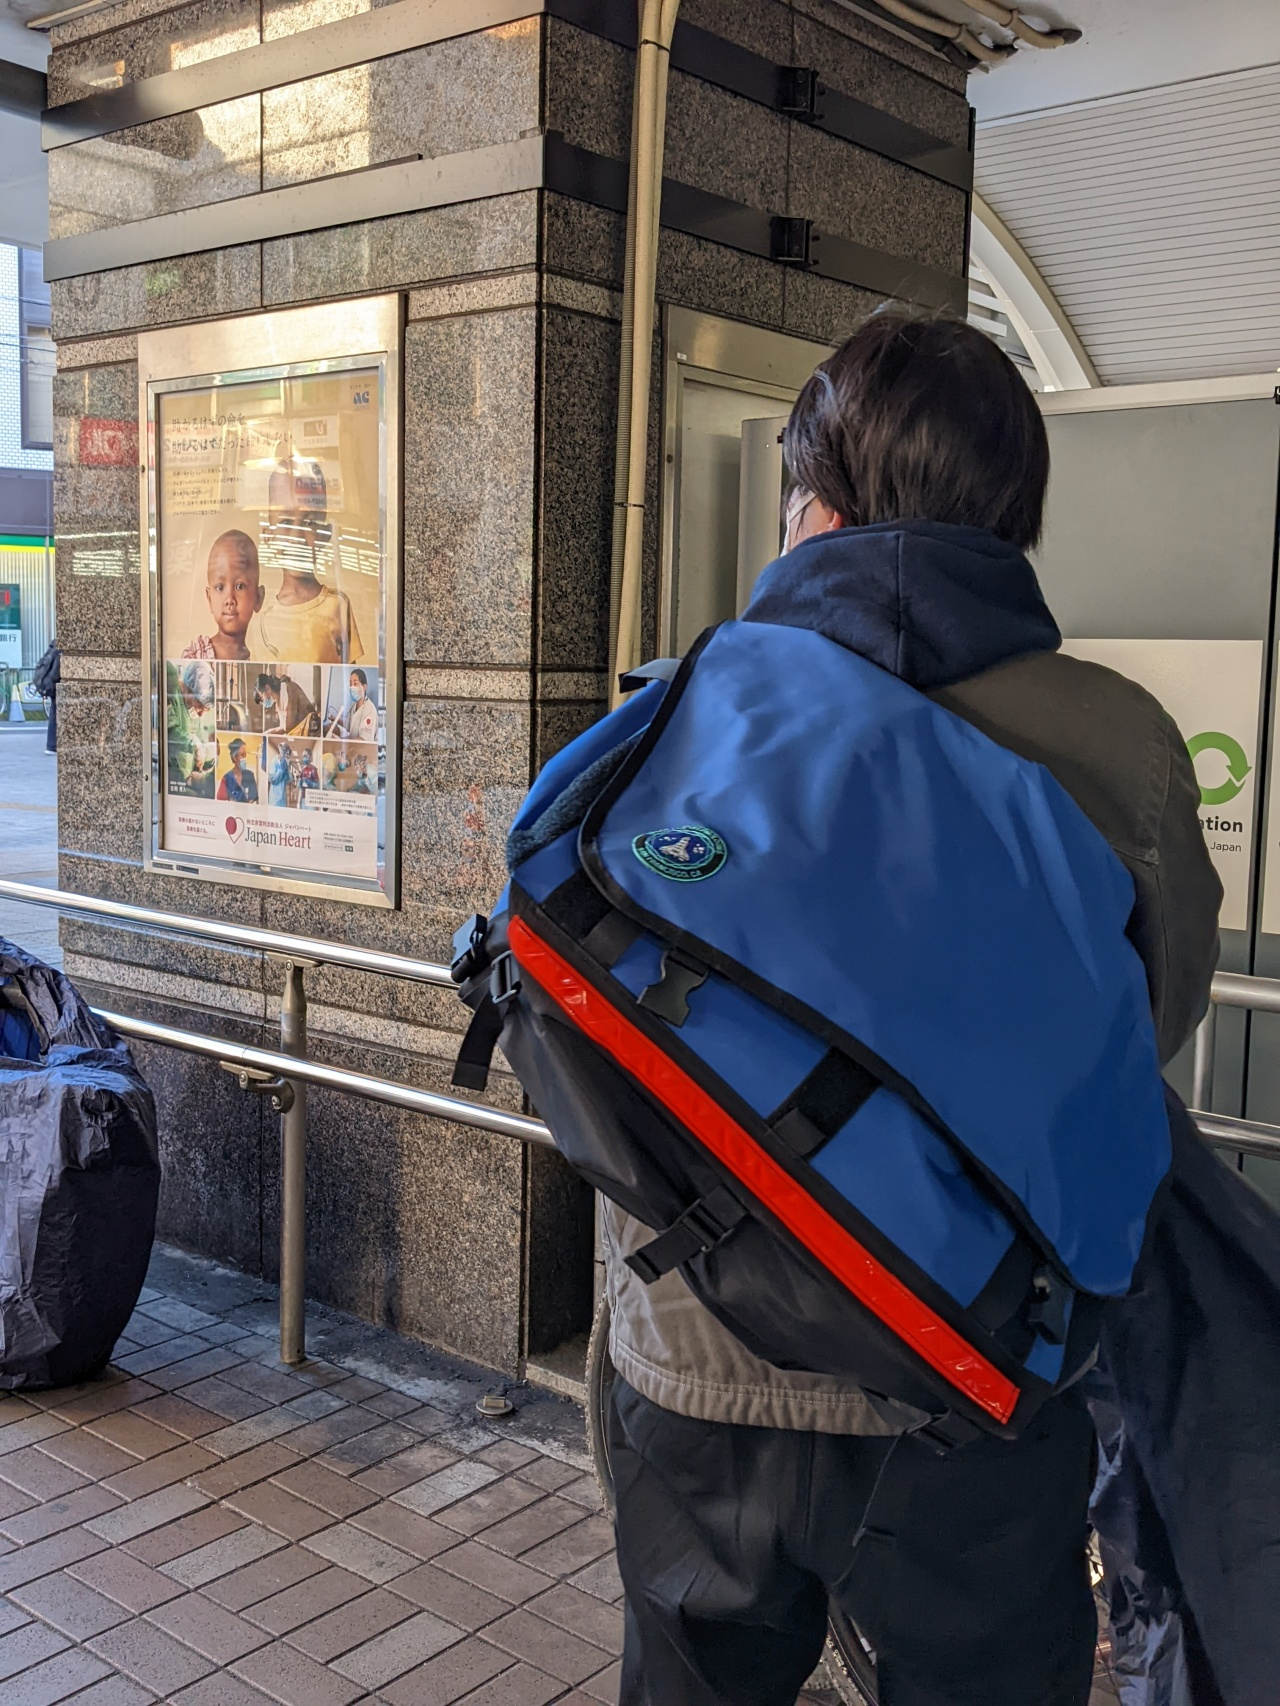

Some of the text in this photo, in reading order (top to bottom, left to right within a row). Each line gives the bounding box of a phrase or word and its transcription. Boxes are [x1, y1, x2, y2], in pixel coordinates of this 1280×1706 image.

[244, 826, 311, 850] Japan Heart
[1210, 841, 1242, 853] Japan
